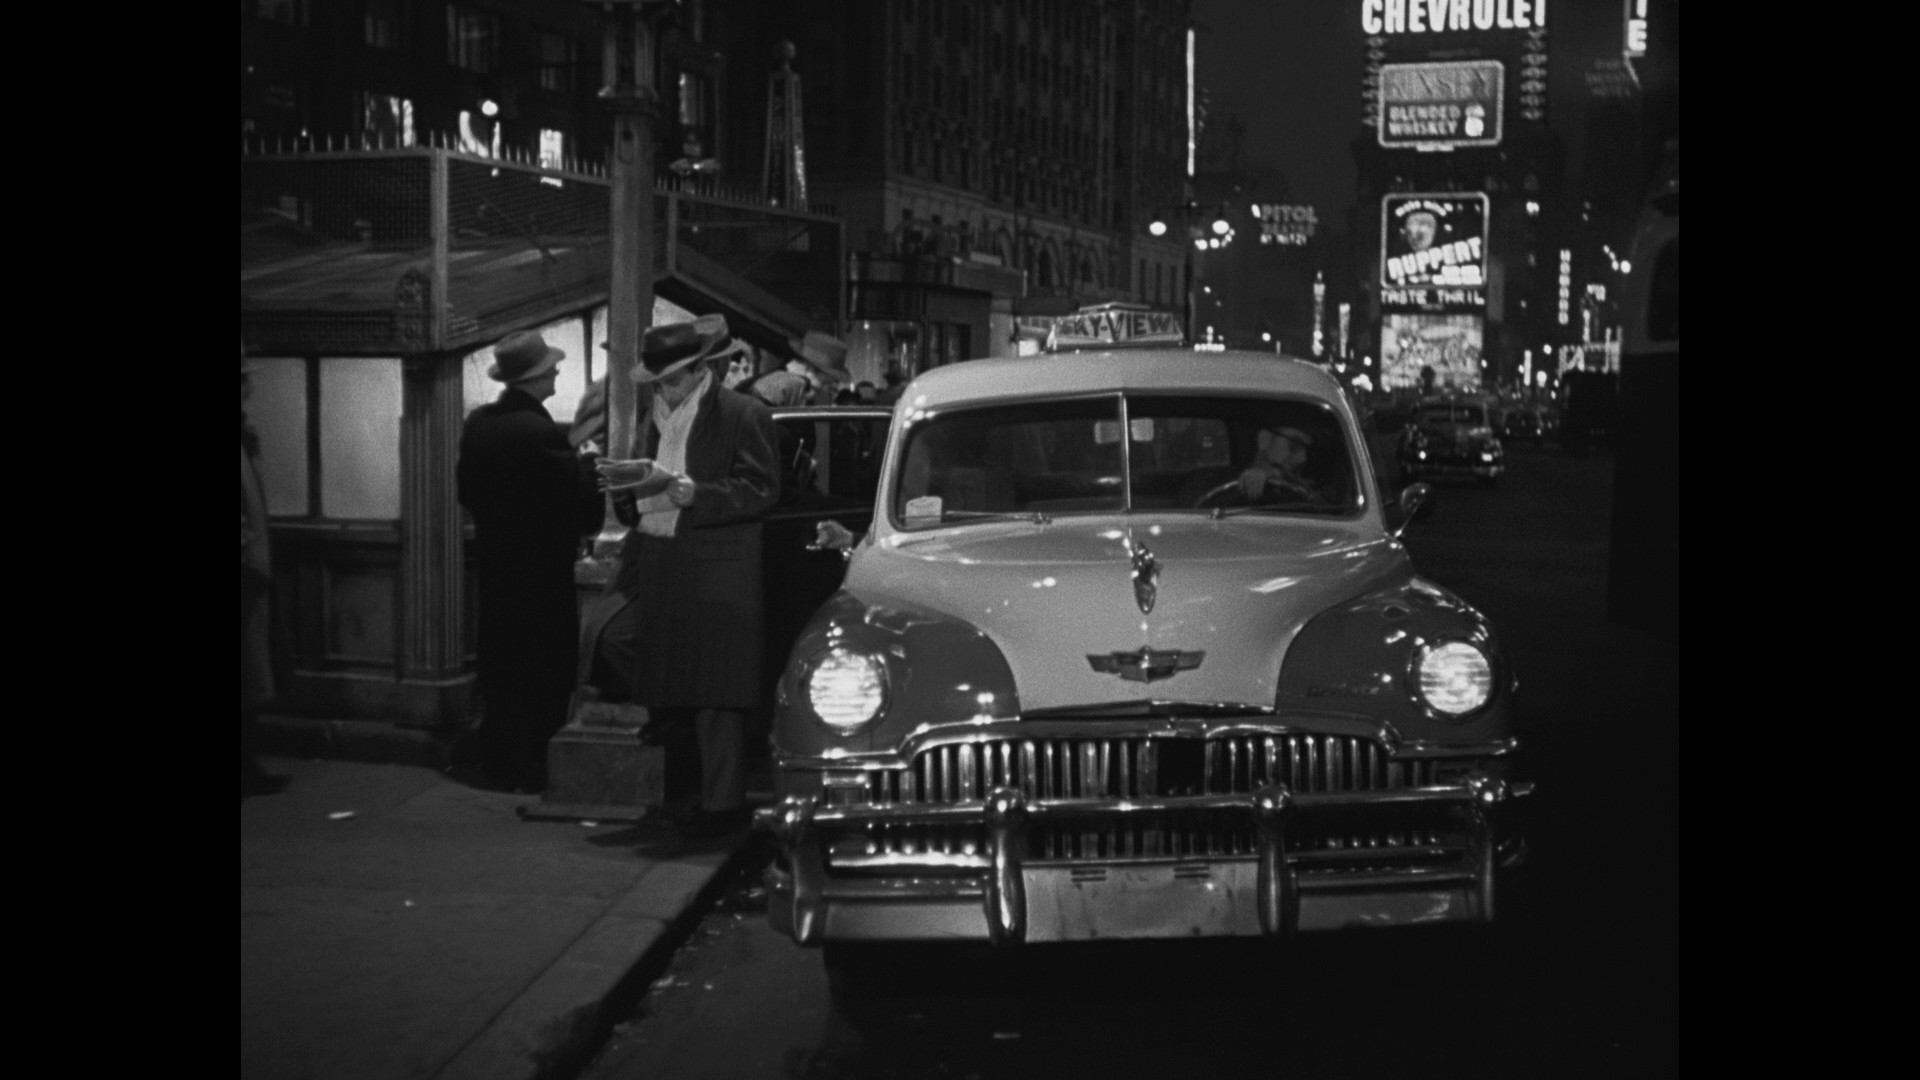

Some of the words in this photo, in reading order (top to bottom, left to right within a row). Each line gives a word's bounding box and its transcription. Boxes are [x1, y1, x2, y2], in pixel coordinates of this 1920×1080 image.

[1361, 0, 1547, 34] CHEVROLET
[1388, 104, 1462, 121] BLENDED
[1388, 120, 1459, 137] WHISKEY
[1387, 236, 1482, 281] RUPPERT
[1381, 289, 1428, 305] TASTE
